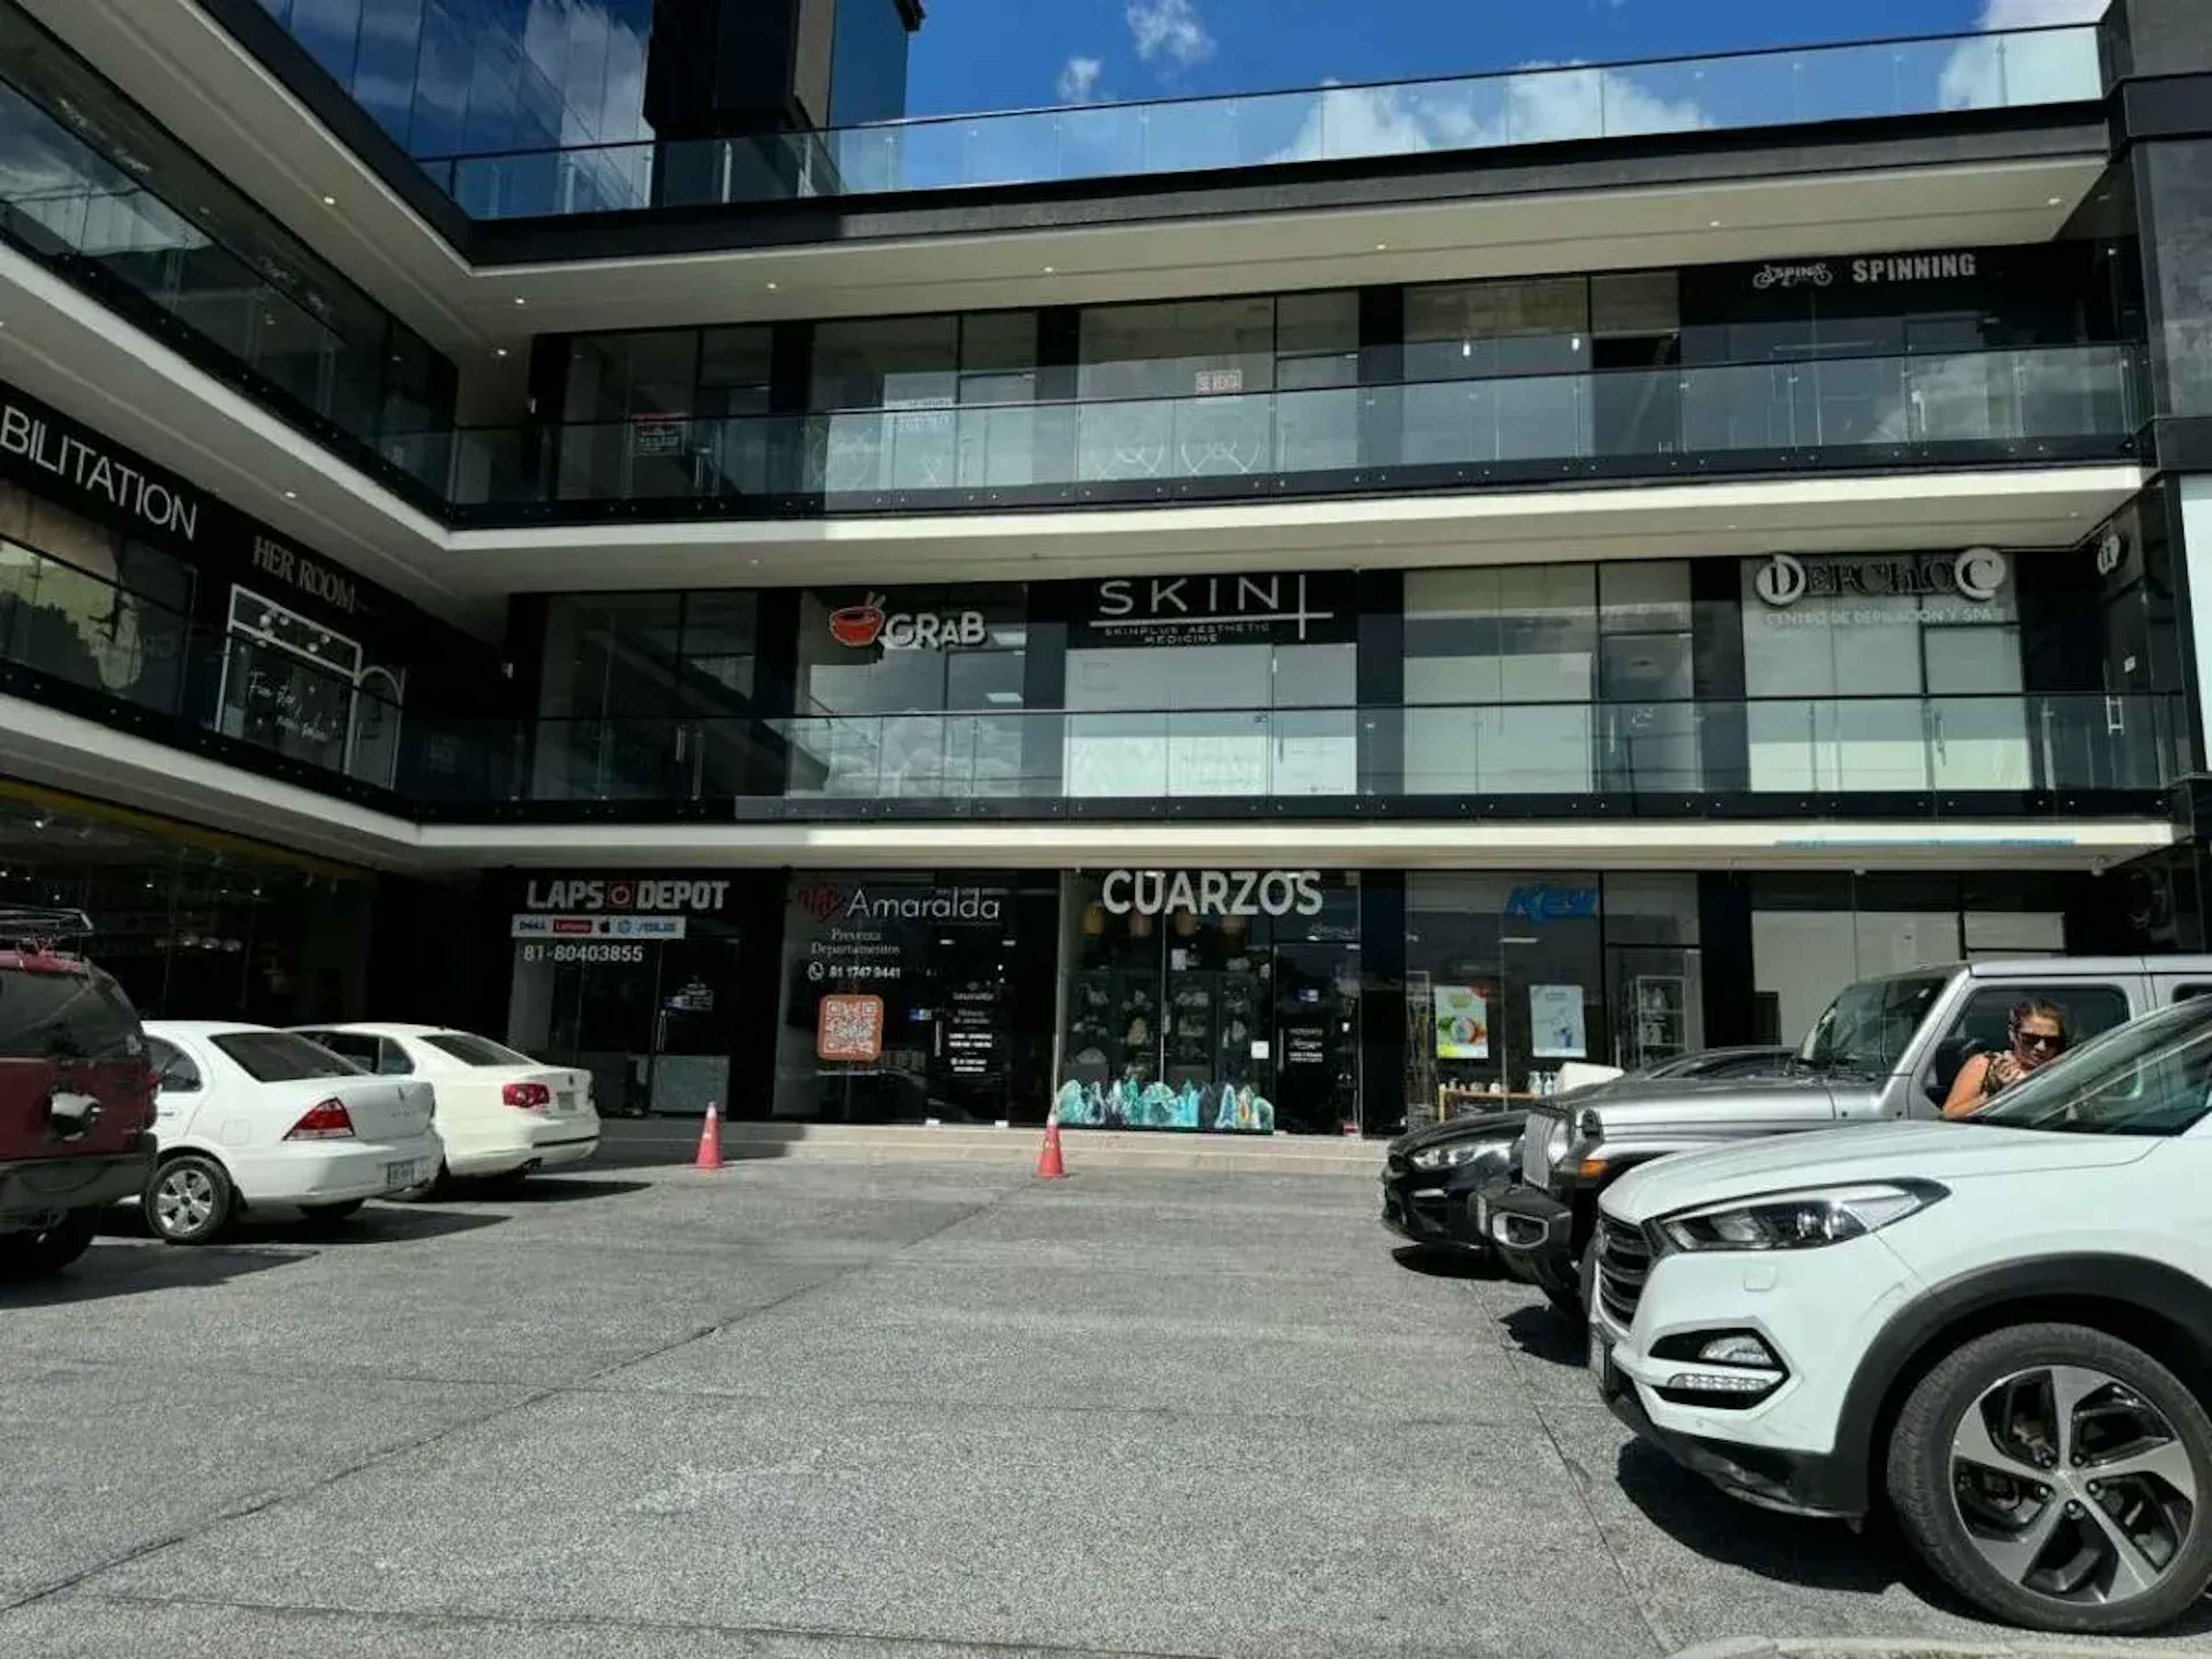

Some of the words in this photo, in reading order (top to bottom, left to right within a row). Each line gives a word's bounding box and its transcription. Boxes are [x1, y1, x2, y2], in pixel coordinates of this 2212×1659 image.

[1853, 254, 1976, 283] SPINNING
[1, 405, 198, 541] BILITATION
[252, 535, 294, 584] HER
[297, 559, 355, 613] ROOM
[1105, 626, 1179, 637] SKINPLUS
[1188, 623, 1270, 635] AESTHETIC
[1766, 612, 1827, 626] CENTRO
[1832, 610, 1850, 623] DE
[1946, 608, 1955, 620] Y
[1962, 608, 1992, 621] SPA
[1143, 634, 1218, 644] MEDICINE
[527, 880, 604, 910] LAPS
[637, 880, 730, 910] DEPOT
[846, 887, 1000, 919] Amaralda
[1103, 870, 1323, 915] CUARZOS
[524, 944, 643, 961] 81-80403855
